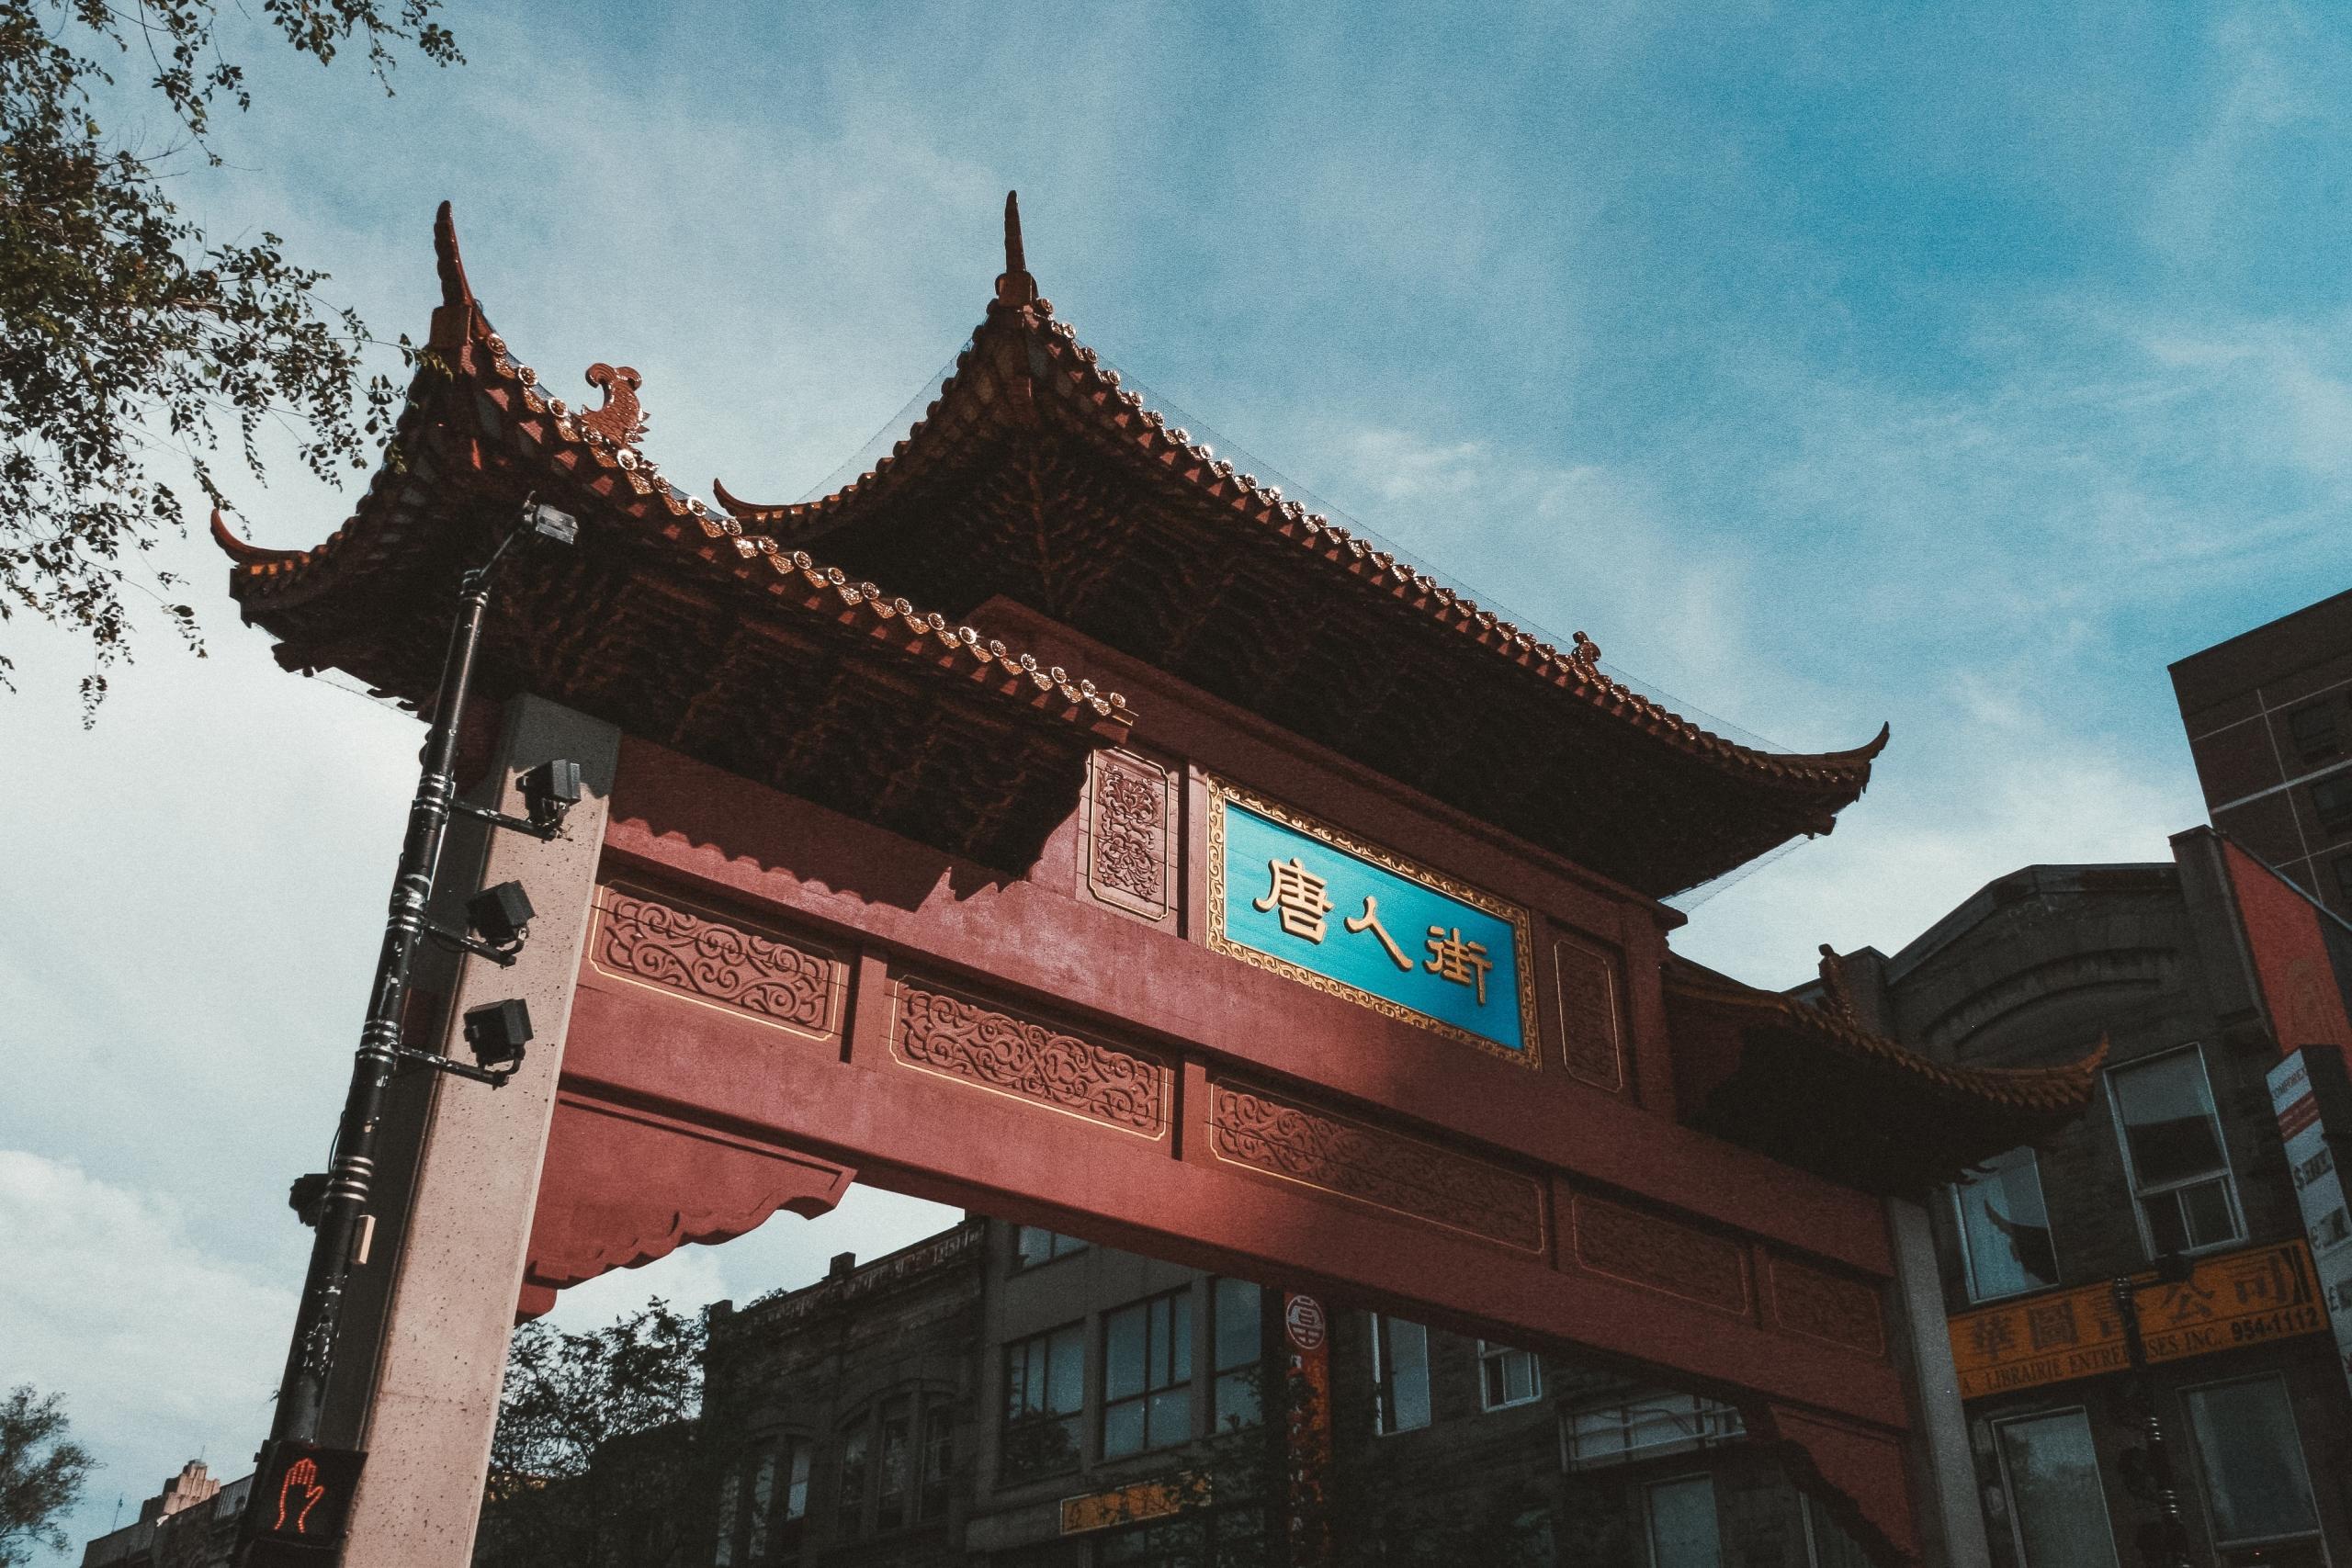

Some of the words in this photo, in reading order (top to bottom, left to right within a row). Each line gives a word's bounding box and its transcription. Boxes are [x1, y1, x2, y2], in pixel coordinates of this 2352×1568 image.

[1253, 858, 1493, 1006] 唐人街
[1984, 1359, 2063, 1391] LIBRAIRIE
[2186, 1327, 2222, 1352] INC.
[2231, 1307, 2319, 1343] 954-1112
